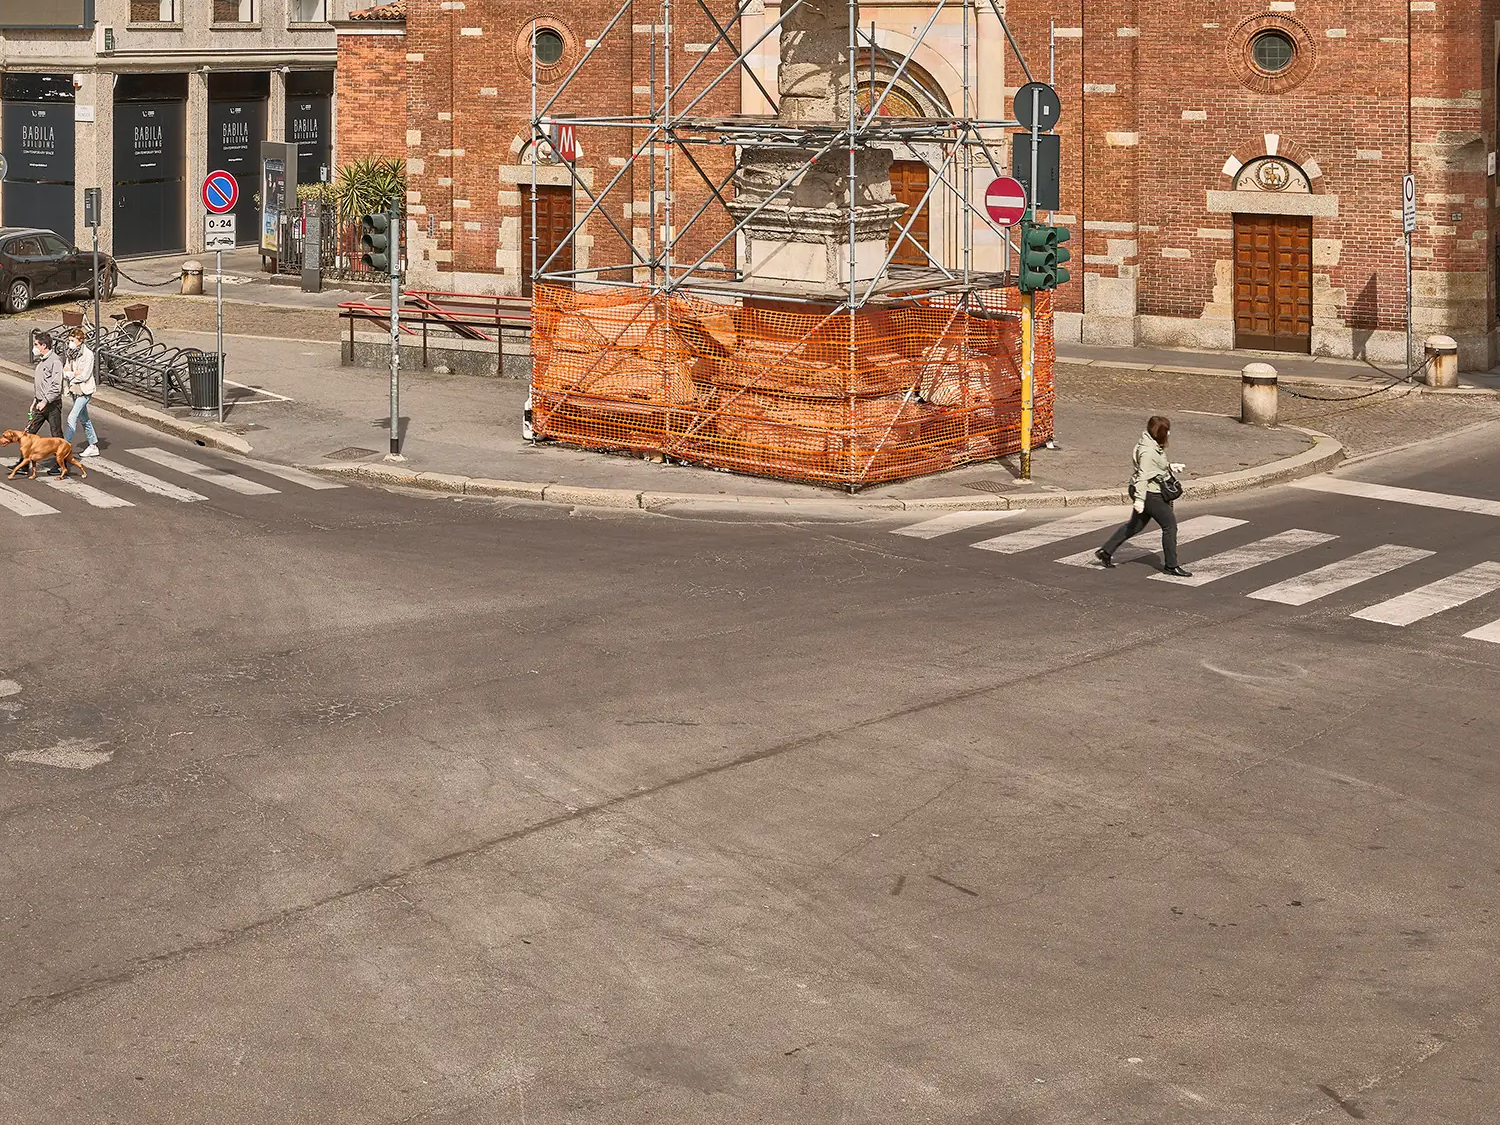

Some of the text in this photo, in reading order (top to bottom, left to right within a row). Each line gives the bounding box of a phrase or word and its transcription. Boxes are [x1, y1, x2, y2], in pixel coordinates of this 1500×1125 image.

[22, 125, 55, 141] BABILA
[134, 125, 163, 141] BABILA
[222, 121, 249, 137] BABILA
[293, 118, 318, 133] BABILA
[22, 140, 55, 149] BUILDING
[560, 126, 575, 153] M
